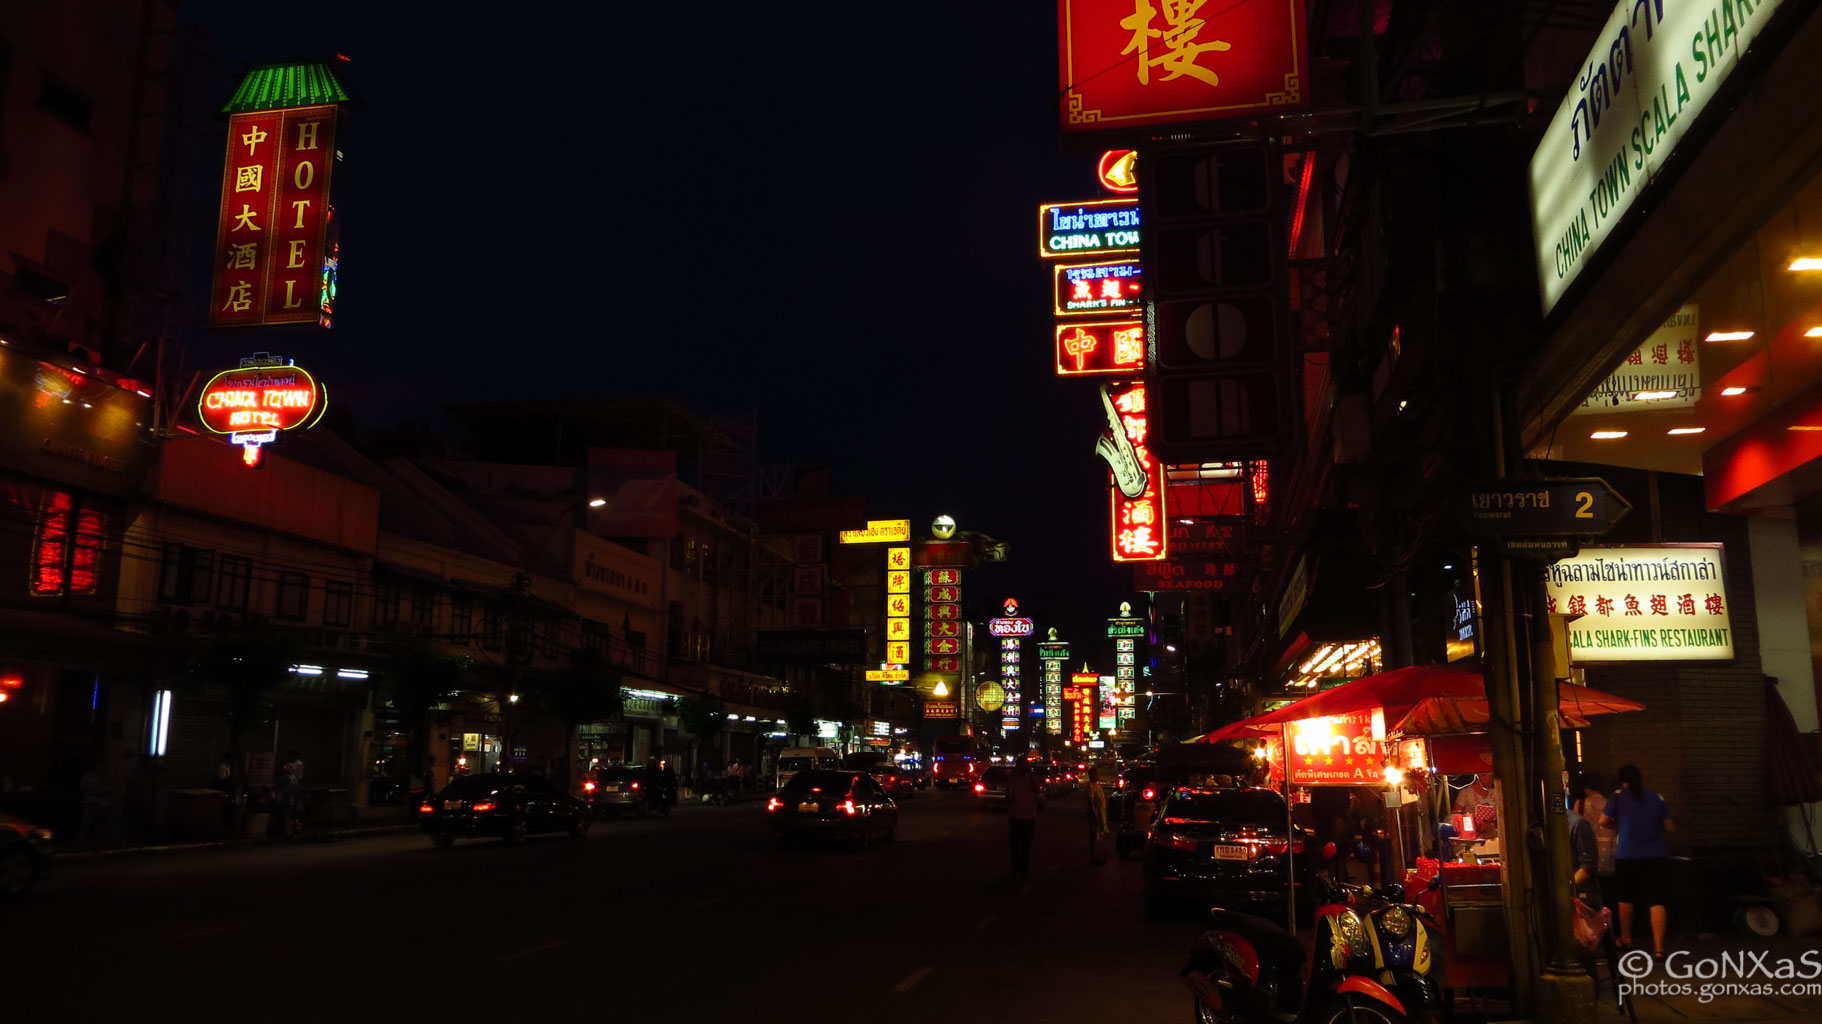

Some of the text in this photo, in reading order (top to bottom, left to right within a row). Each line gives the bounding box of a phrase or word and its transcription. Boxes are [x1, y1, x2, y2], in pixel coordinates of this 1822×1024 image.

[1120, 0, 1231, 86] 樓
[1555, 0, 1763, 279] CHINA TOWN SCALA SHAR
[222, 126, 268, 312] 中國大酒店
[282, 122, 320, 309] HOTEL
[1049, 234, 1101, 250] CHINA
[1067, 300, 1107, 310] SHARK'S
[1064, 328, 1142, 370] 中國
[206, 390, 310, 409] CHINA TOWN
[229, 411, 281, 426] HOTEL
[1472, 490, 1594, 518] เยาวราช 2
[1158, 580, 1223, 589] SEAFOOD
[1597, 629, 1659, 648] SHARK-FINS
[1661, 628, 1729, 647] RESTAURANT
[1353, 767, 1364, 778] A
